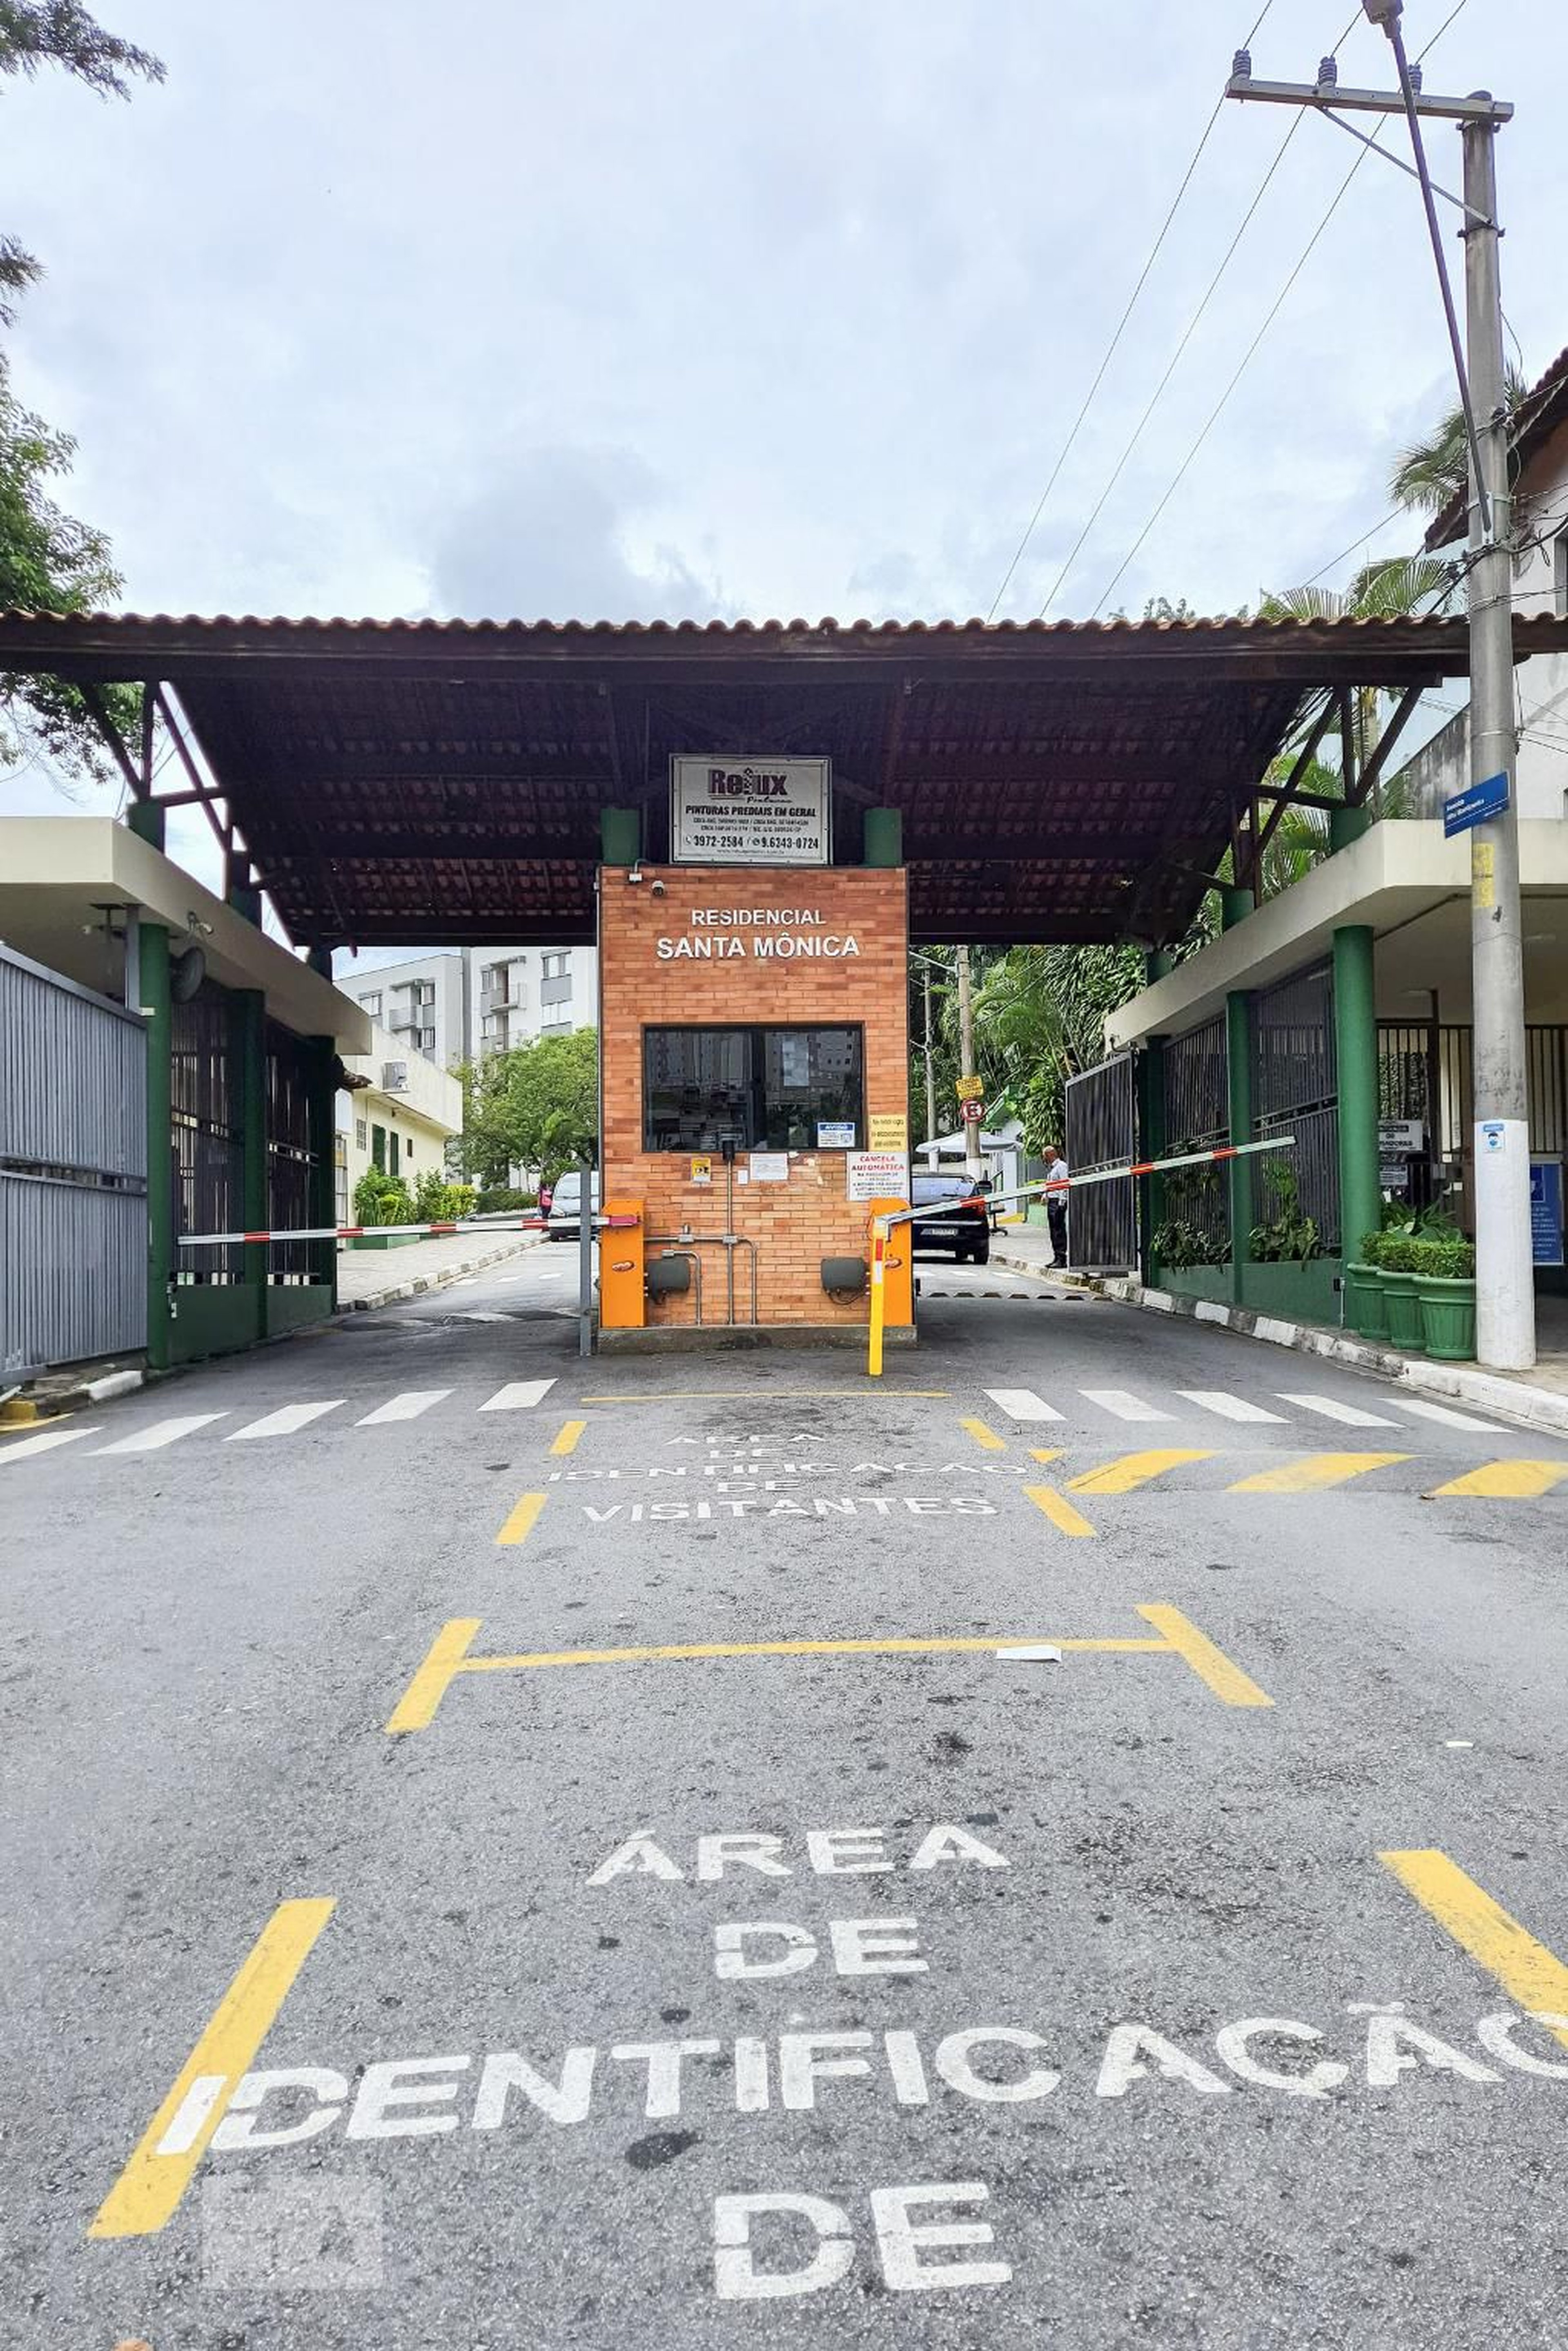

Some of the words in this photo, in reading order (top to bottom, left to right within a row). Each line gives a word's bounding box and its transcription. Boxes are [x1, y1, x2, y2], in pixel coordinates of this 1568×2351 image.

[686, 805, 729, 815] PINTURAS
[731, 807, 772, 816] PREDIAIS
[774, 807, 786, 816] EM
[789, 808, 816, 817] GERAL
[692, 909, 826, 926] RESIDENCIAL
[657, 937, 746, 958] SANTA
[753, 933, 860, 957] MÔNICA
[710, 1448, 783, 1459] DE
[717, 1480, 800, 1492] DE
[581, 1497, 999, 1521] VISITANTES
[586, 1830, 1012, 1885] ÁREA
[714, 1918, 929, 1979] DE
[714, 2182, 1013, 2300] DE
